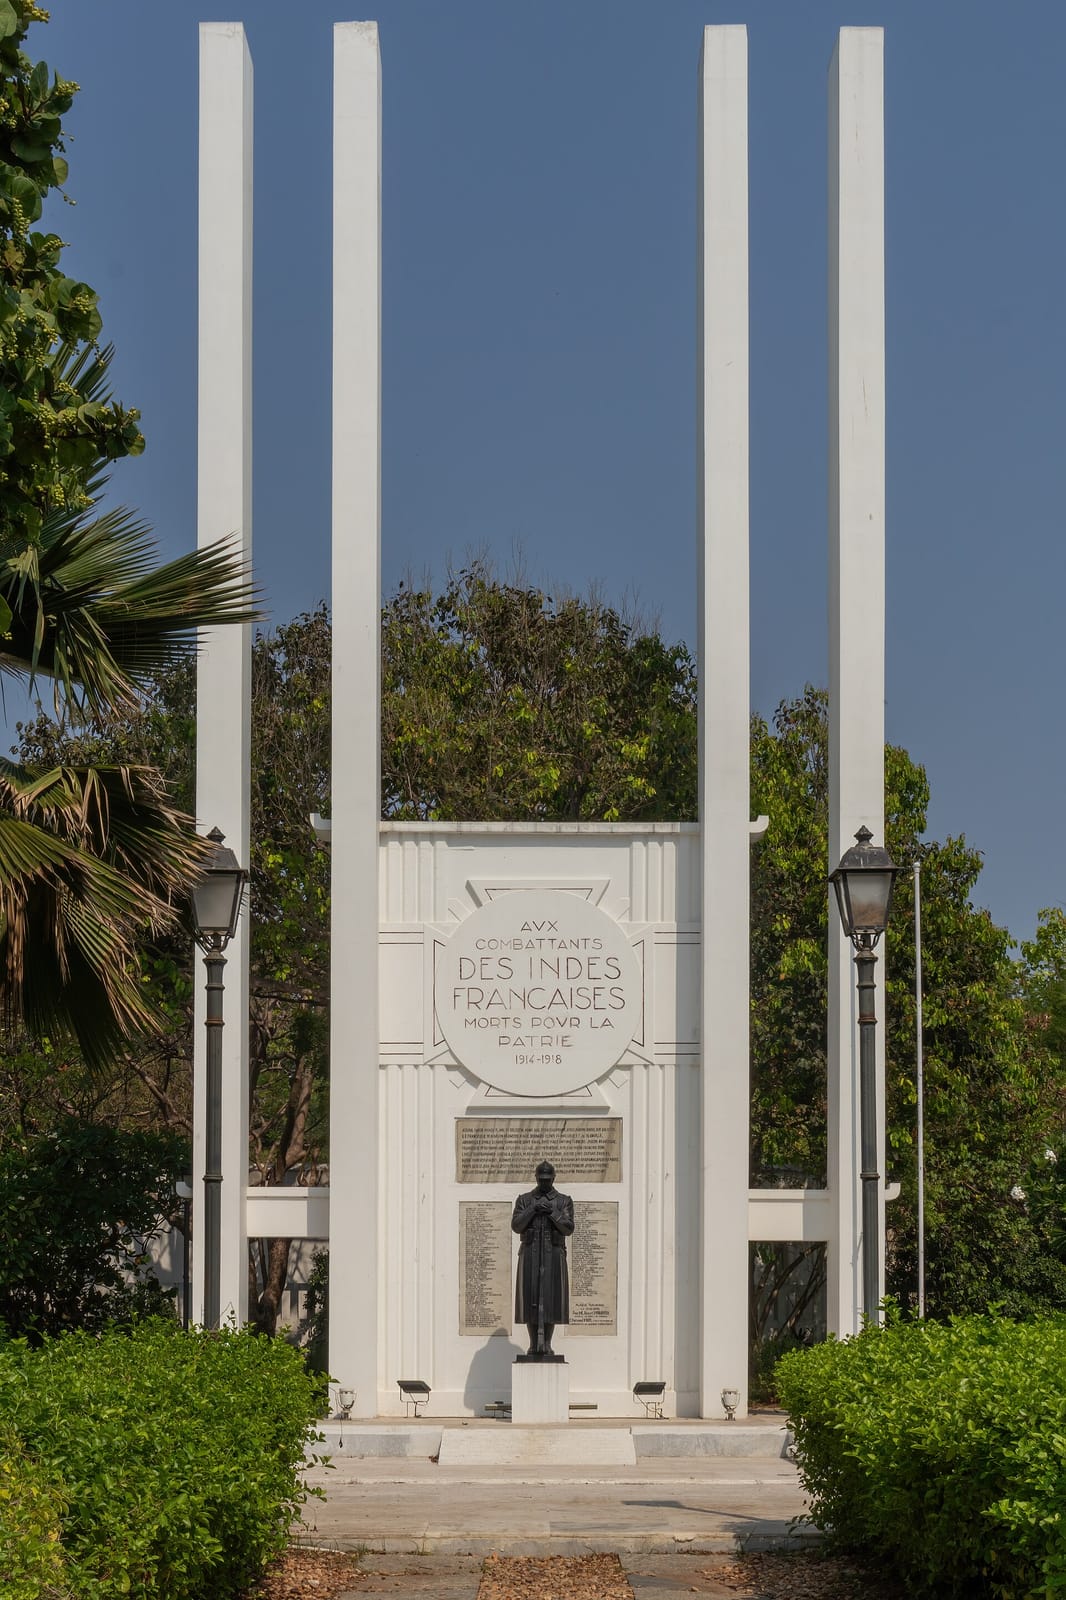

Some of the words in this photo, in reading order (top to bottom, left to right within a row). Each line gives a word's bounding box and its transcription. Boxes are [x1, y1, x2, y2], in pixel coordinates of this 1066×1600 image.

[475, 938, 603, 950] COMBATTANTS
[459, 957, 514, 980] DES
[529, 957, 621, 980] INDES
[453, 987, 626, 1010] FRANCAISES
[464, 1017, 522, 1028] MORTS
[590, 1017, 614, 1028] LA
[498, 1035, 574, 1048] PATRIE
[515, 1055, 562, 1065] 1914-1918
